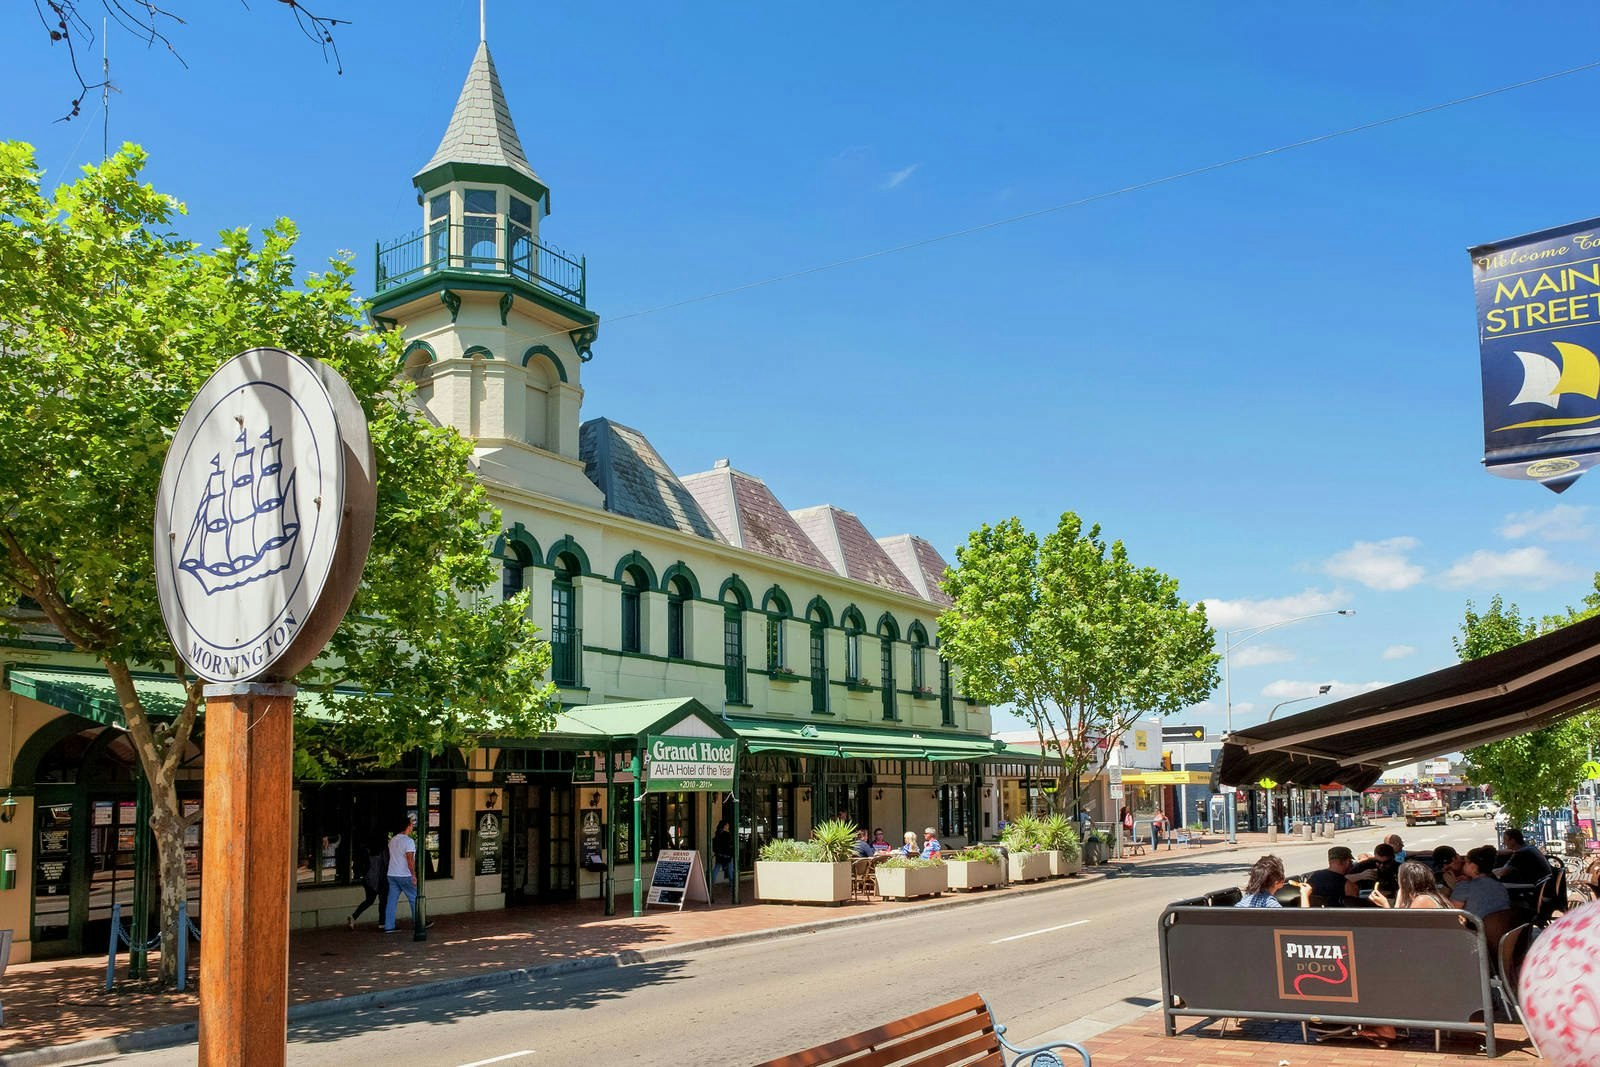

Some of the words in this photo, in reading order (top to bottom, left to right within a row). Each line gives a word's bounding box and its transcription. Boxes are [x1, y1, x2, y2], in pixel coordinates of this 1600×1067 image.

[1478, 246, 1569, 271] Welcome
[1494, 263, 1600, 304] MAIN
[189, 609, 298, 676] MORNINGTON
[653, 740, 697, 760] Grand
[700, 742, 735, 762] Hotel
[655, 764, 675, 776] AHA
[676, 763, 696, 776] Hotel
[698, 764, 705, 776] of
[706, 764, 717, 776] the
[718, 765, 733, 776] Year
[1286, 942, 1344, 960] PIAZZA
